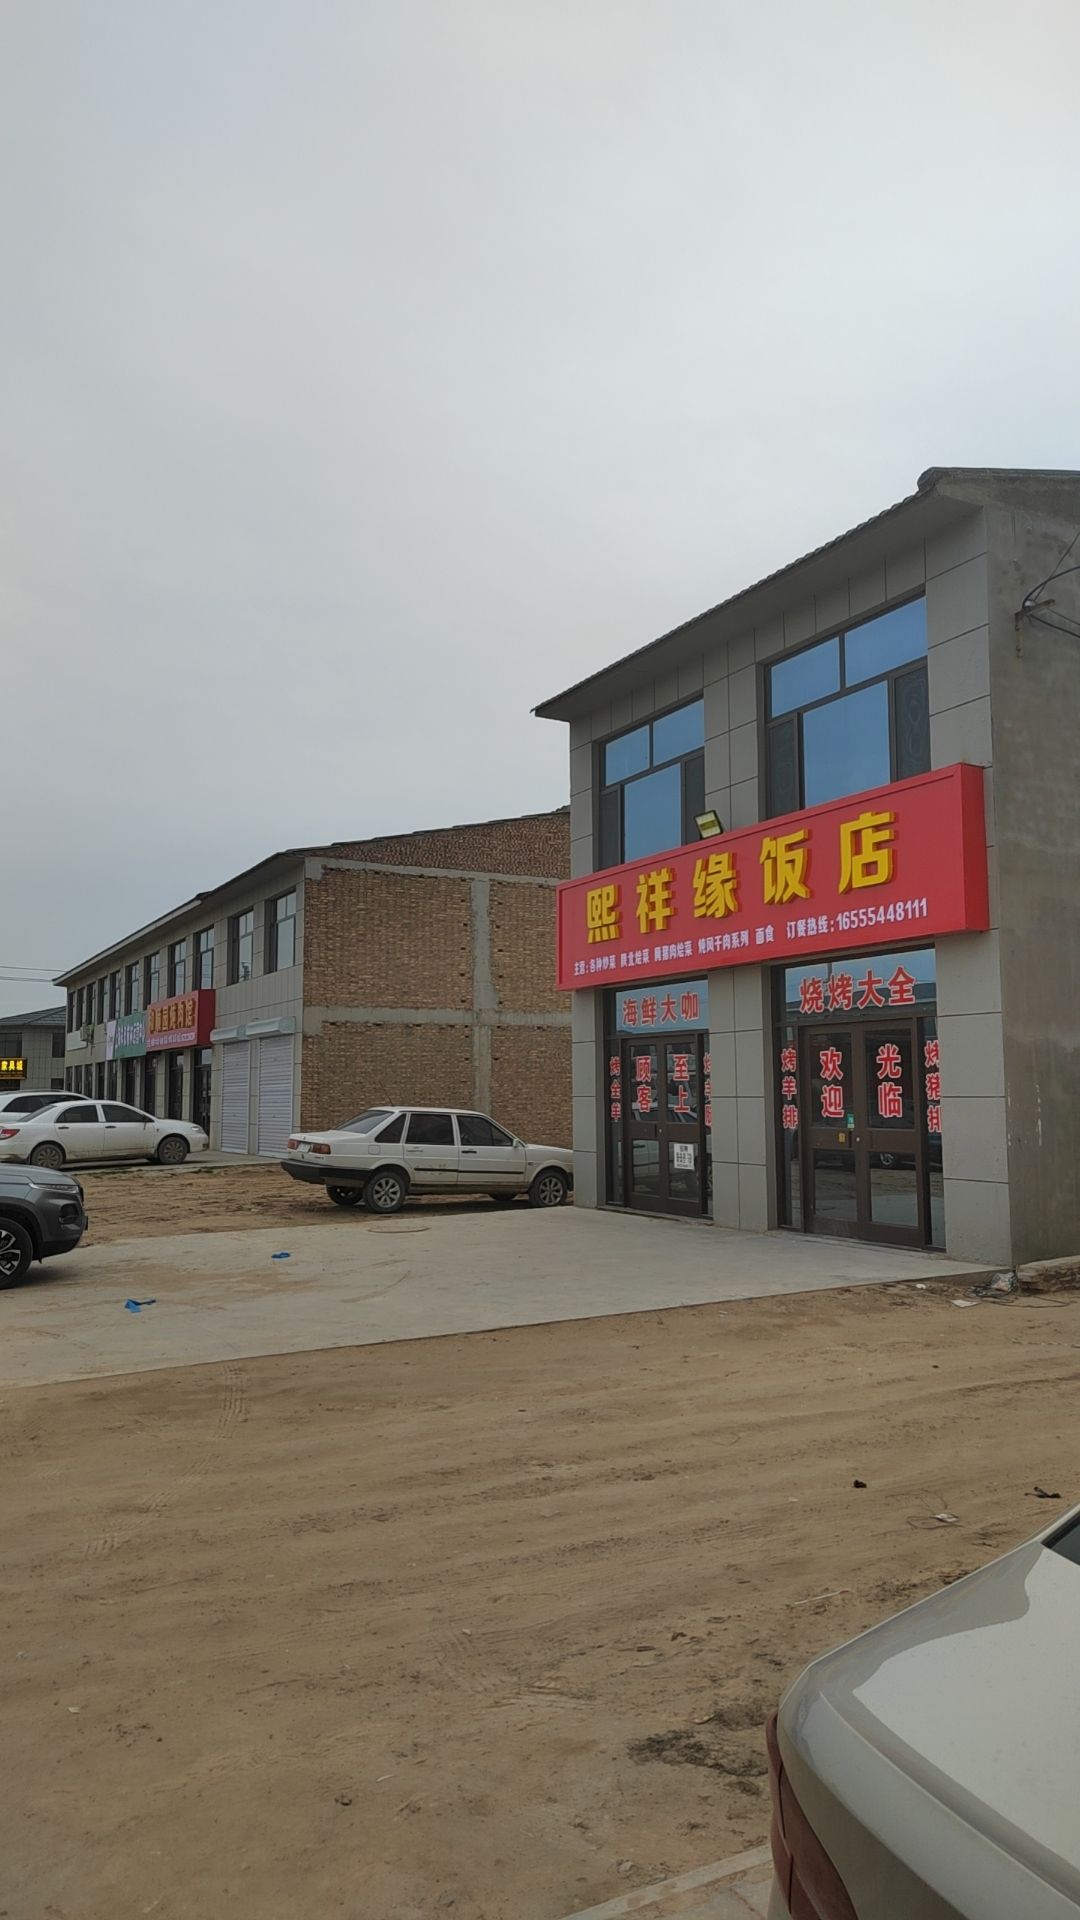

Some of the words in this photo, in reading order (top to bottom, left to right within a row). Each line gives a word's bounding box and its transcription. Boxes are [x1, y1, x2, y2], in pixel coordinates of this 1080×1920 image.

[586, 811, 896, 944] 熙祥缘饭店
[755, 924, 774, 945] 面食
[623, 991, 699, 1027] 海鲜大咖
[800, 965, 916, 1014] 烧烤大全
[636, 1056, 652, 1112] 顾客
[673, 1054, 691, 1112] 至上
[781, 1048, 798, 1129] 烤羊排
[820, 1047, 844, 1118] 欢迎
[876, 1044, 903, 1118] 光临
